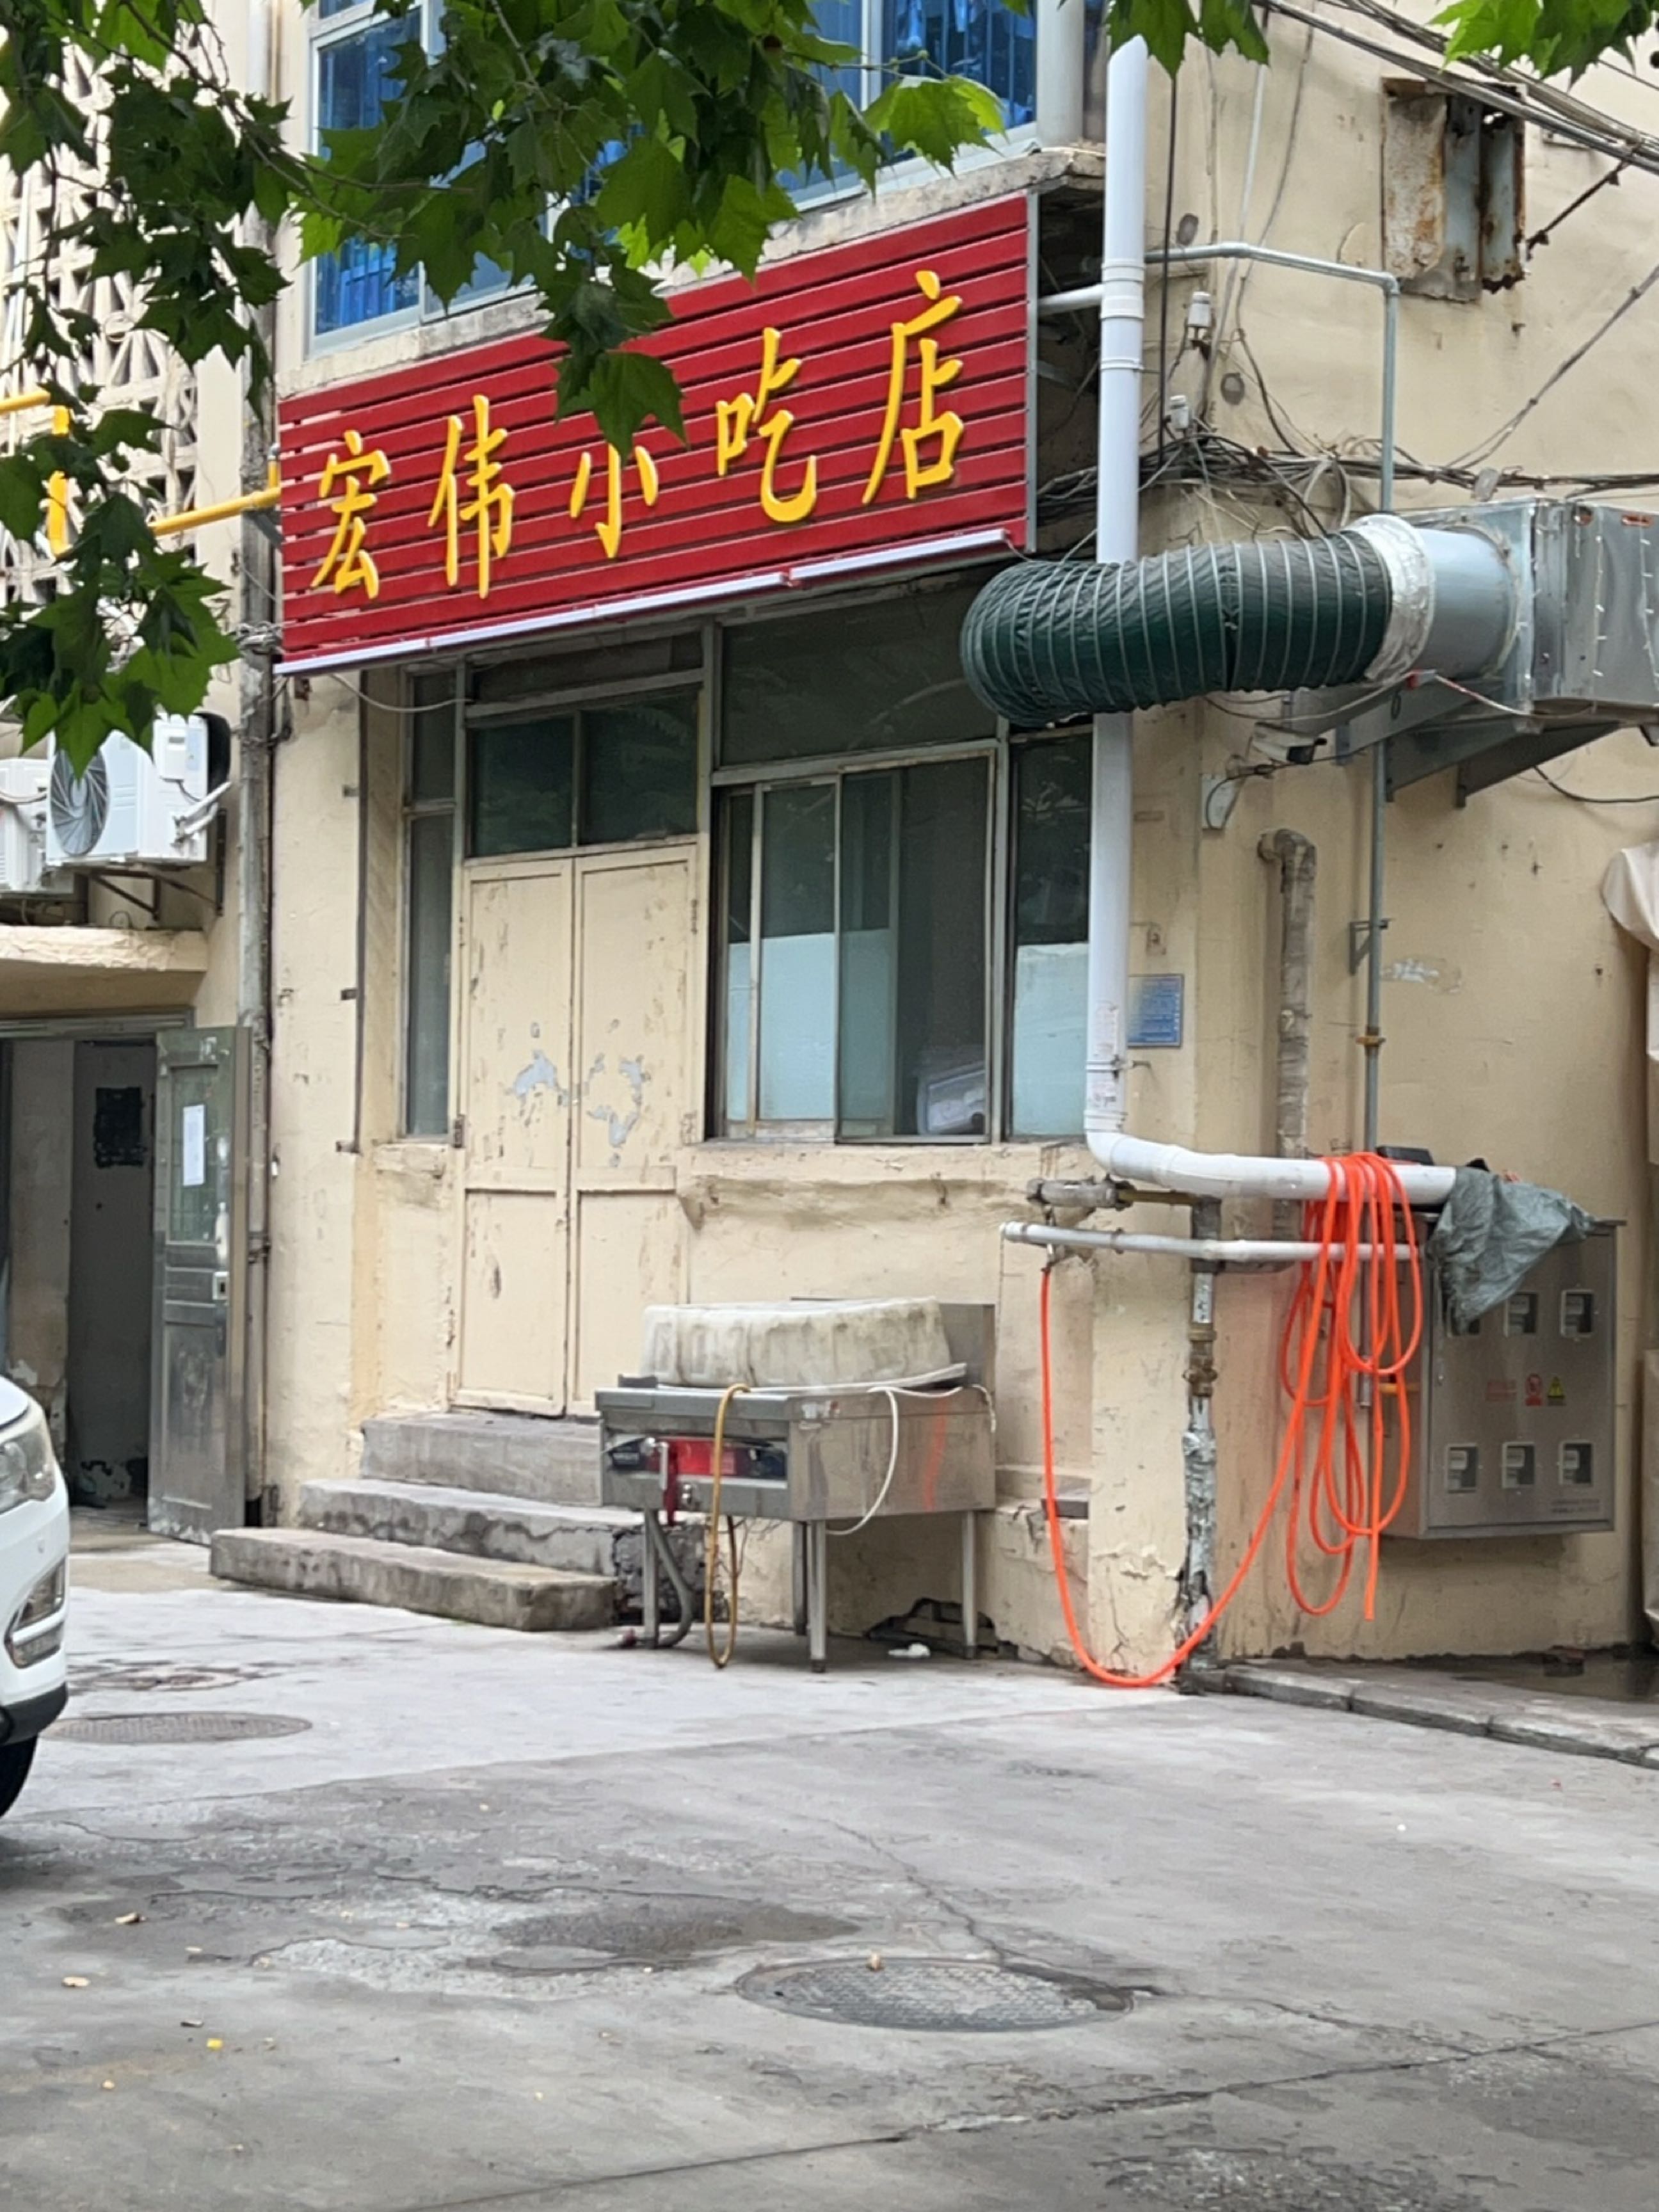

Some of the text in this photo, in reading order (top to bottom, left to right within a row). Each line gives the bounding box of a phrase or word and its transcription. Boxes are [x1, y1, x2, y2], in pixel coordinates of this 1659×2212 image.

[312, 269, 963, 600] 宏伟小吃店
